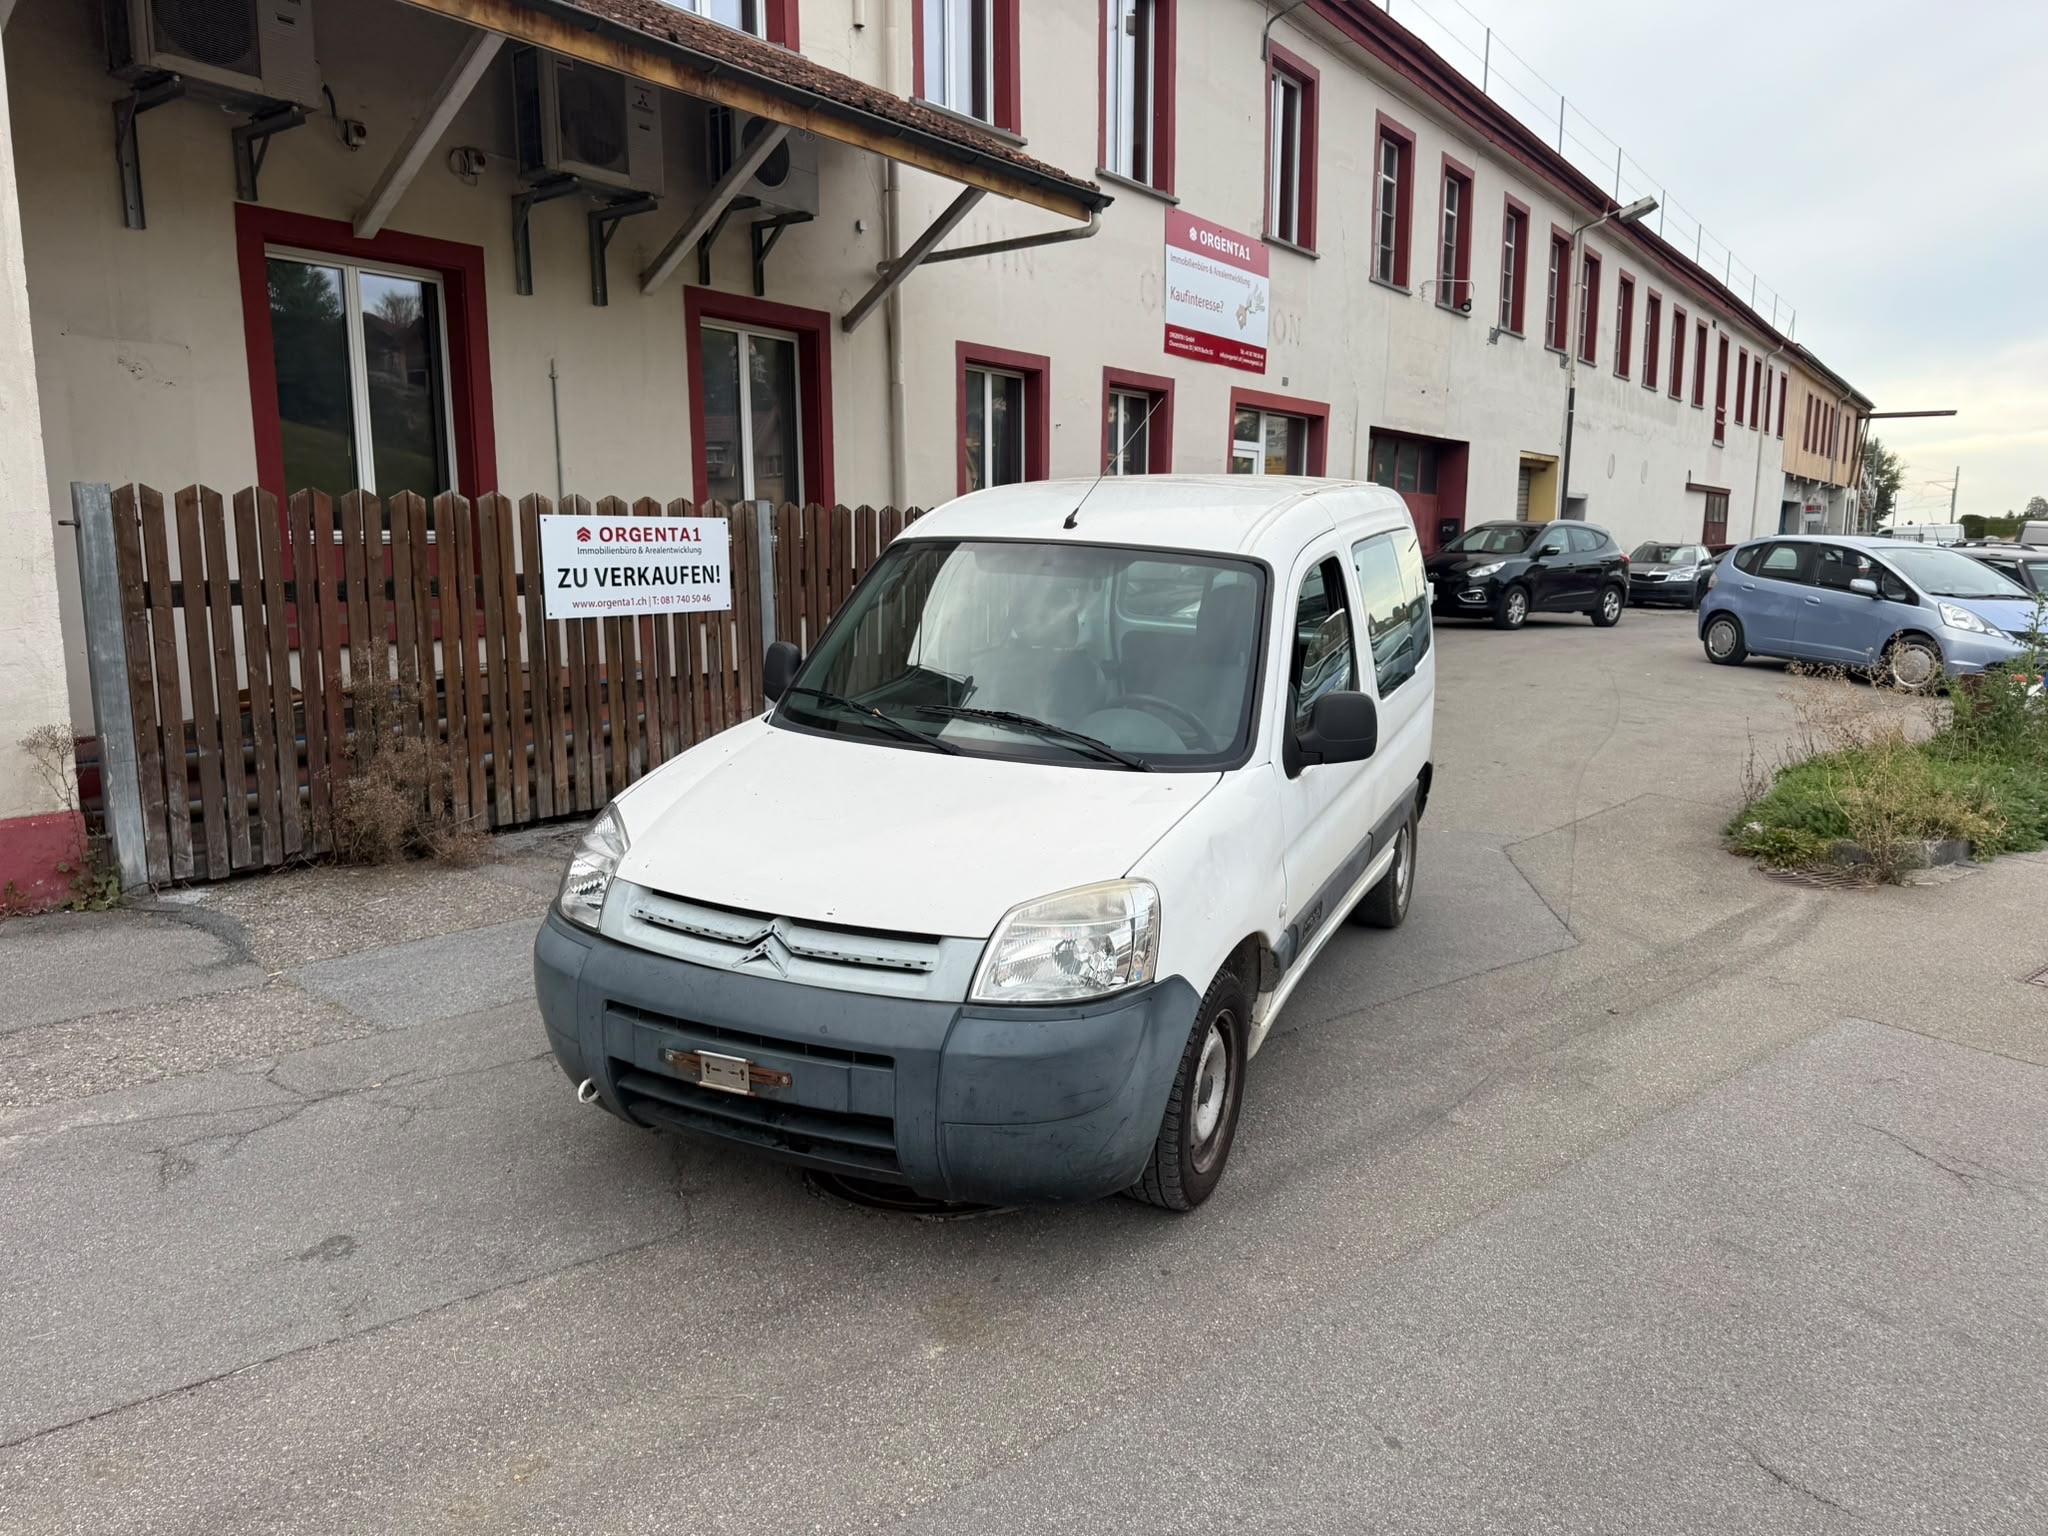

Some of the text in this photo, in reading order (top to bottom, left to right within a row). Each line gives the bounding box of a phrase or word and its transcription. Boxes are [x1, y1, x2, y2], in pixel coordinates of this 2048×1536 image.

[1200, 230, 1250, 261] ORGENTA1
[1170, 286, 1224, 313] Kaufinteresse?
[600, 527, 702, 542] ORGENTA1
[577, 546, 637, 555] Immobilienbüro
[644, 546, 702, 556] Arealentwicklung
[557, 565, 721, 589] ZU VERKAUFEN!
[572, 597, 647, 610] www.orgenta1.ch
[652, 596, 660, 605] T:
[660, 595, 675, 605] 081
[676, 595, 690, 604] 740
[691, 594, 701, 603] 50
[702, 593, 712, 603] 46
